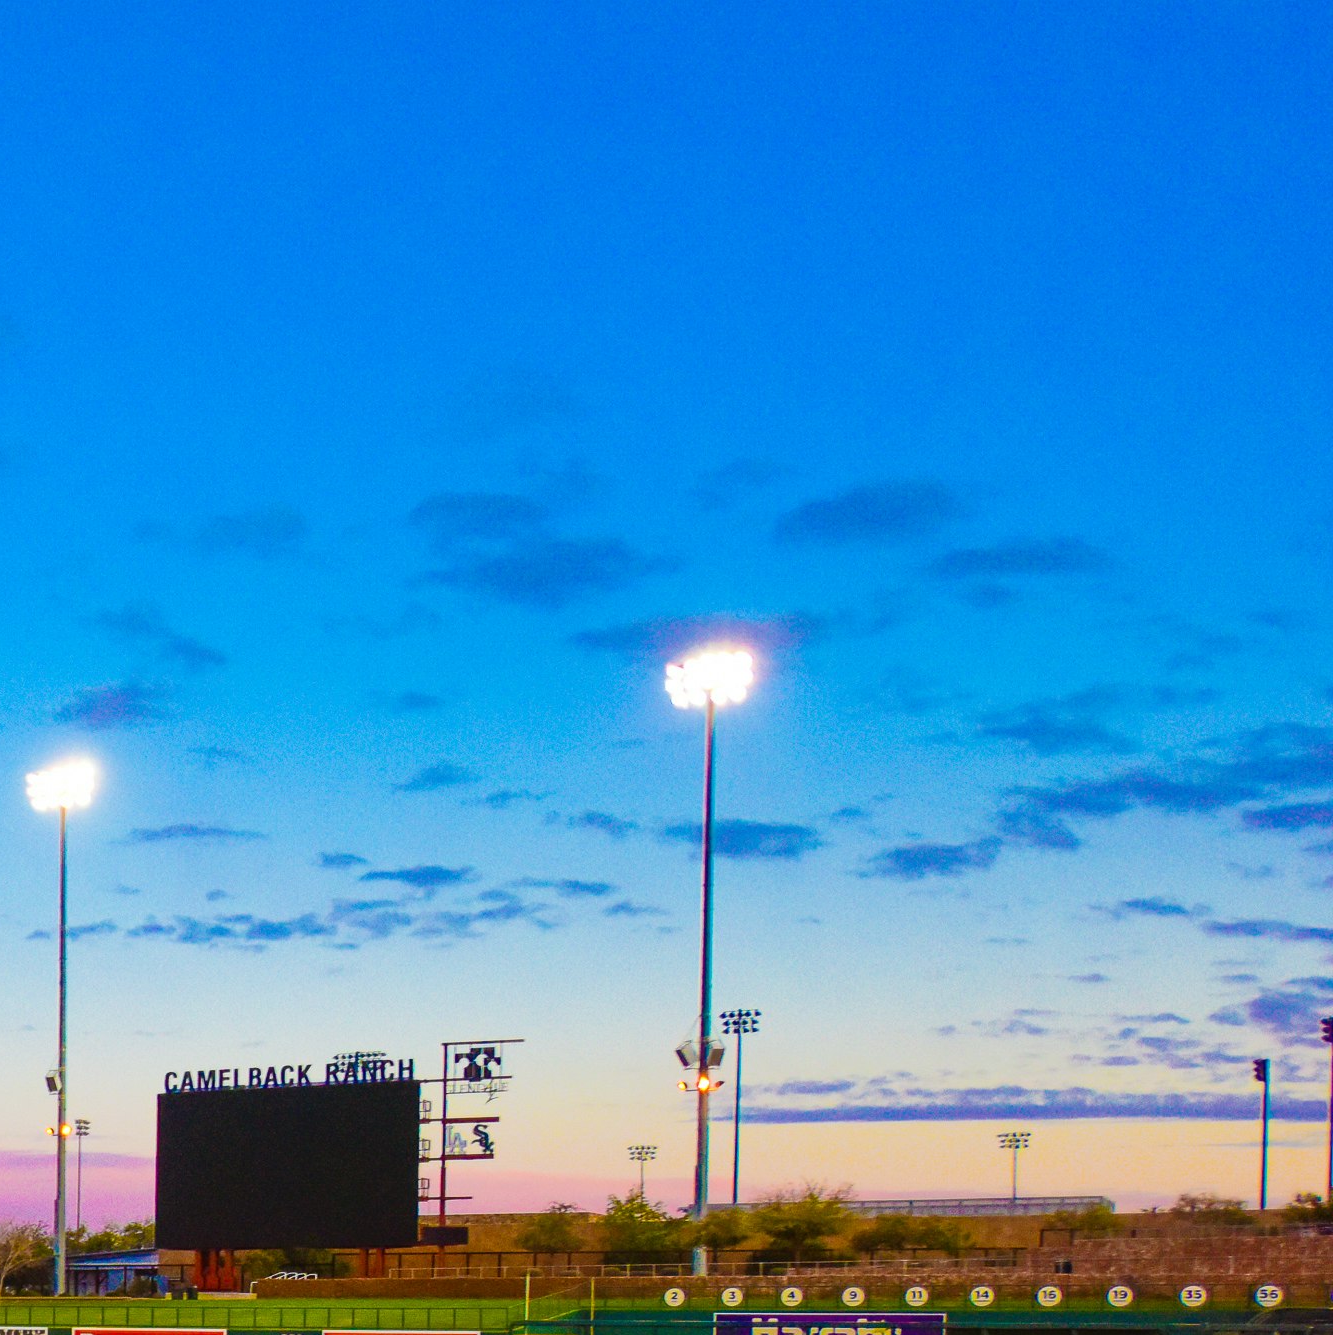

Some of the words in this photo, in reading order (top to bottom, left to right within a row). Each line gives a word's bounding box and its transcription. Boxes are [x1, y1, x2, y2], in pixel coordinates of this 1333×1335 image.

[164, 1064, 312, 1094] CAMELBACK
[326, 1058, 415, 1084] RANCH
[671, 1291, 678, 1299] 2
[729, 1291, 736, 1299] 3
[787, 1291, 795, 1299] 4
[849, 1290, 857, 1299] 9
[911, 1290, 923, 1299] 11
[975, 1290, 989, 1299] 14
[1042, 1290, 1057, 1299] 16
[1113, 1290, 1128, 1299] 19
[1185, 1290, 1202, 1299] 35
[1259, 1289, 1278, 1299] 56
